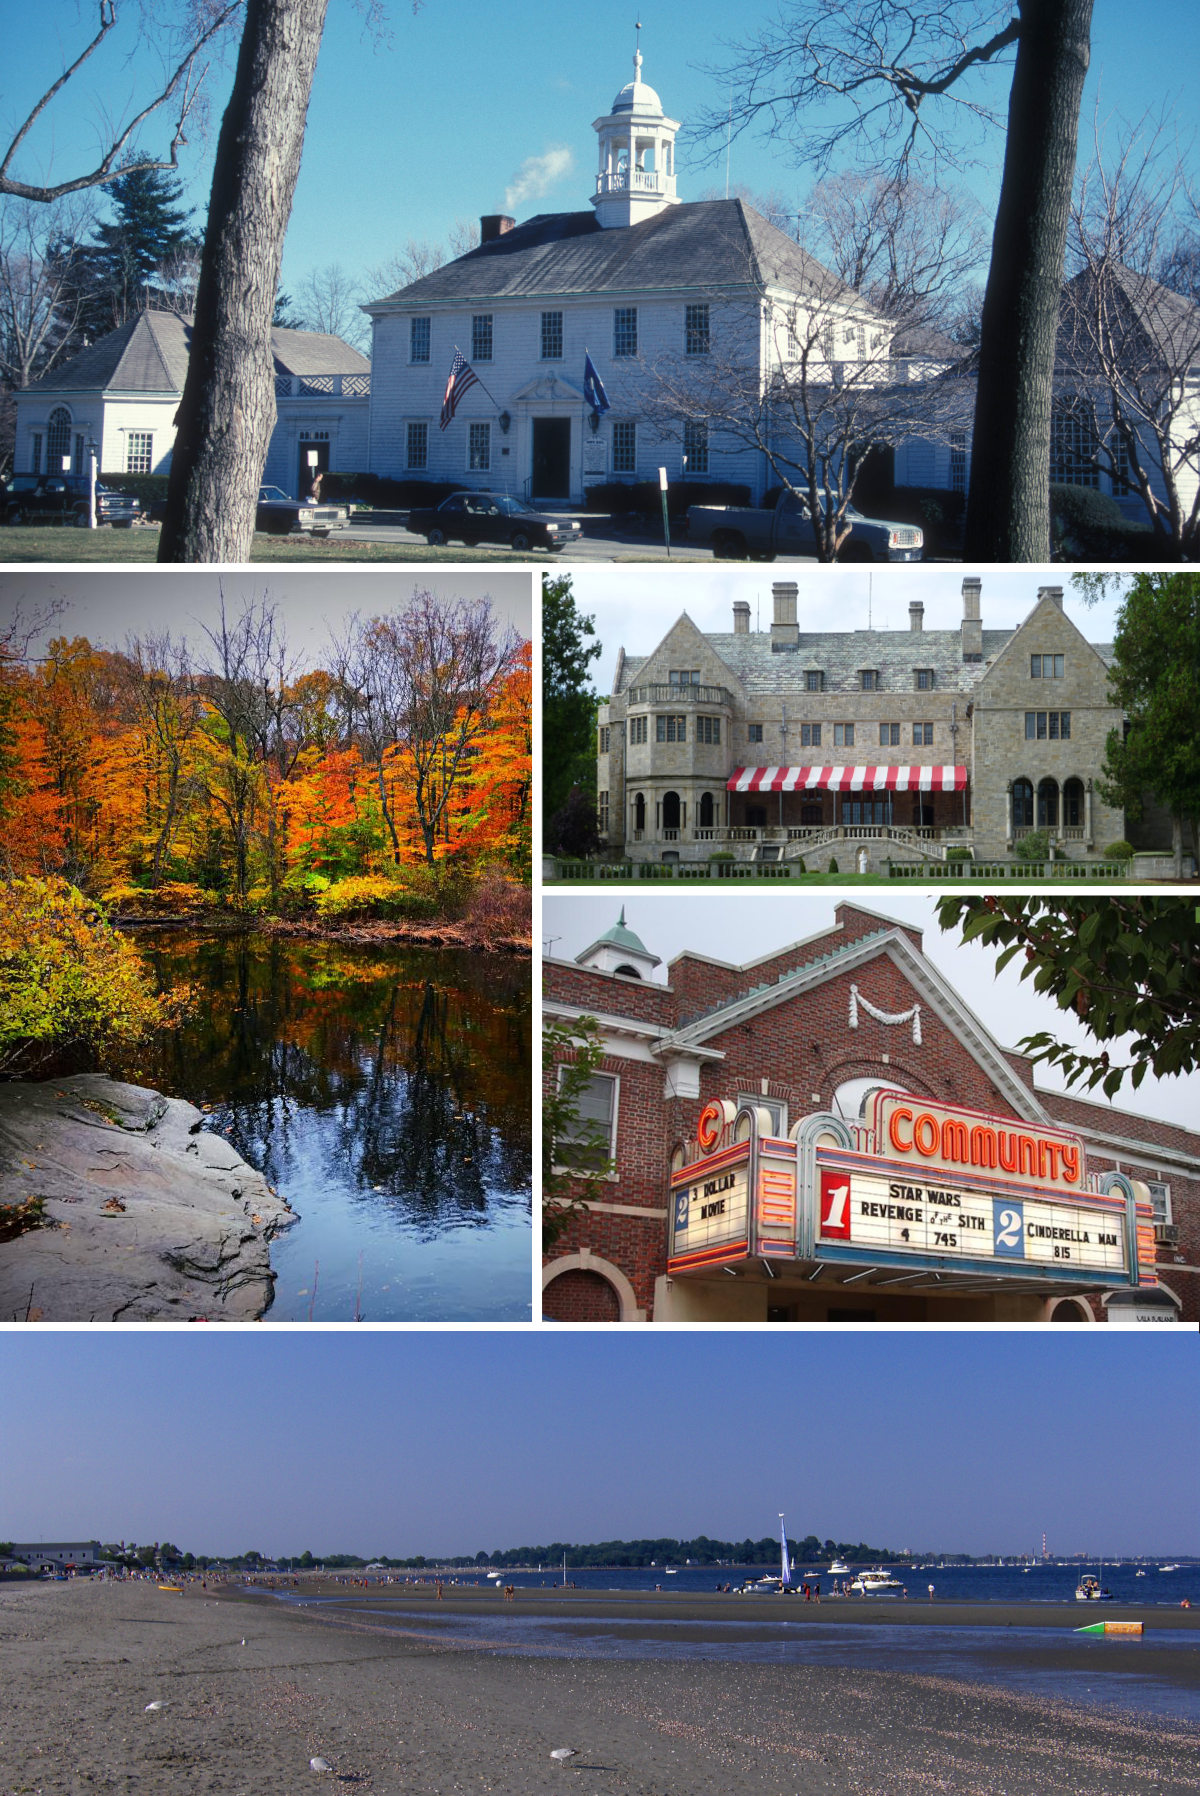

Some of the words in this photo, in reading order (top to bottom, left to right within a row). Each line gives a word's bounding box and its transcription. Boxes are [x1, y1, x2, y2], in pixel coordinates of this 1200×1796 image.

[692, 1187, 698, 1200] 3
[703, 1173, 735, 1198] DOLLAR
[890, 1183, 923, 1202] STAR
[927, 1189, 961, 1208] WARS
[676, 1196, 688, 1224] 2
[701, 1199, 725, 1220] MOVIE
[822, 1185, 849, 1228] 1
[861, 1202, 923, 1222] REVENGE
[930, 1211, 939, 1224] OF
[939, 1213, 952, 1225] THE
[958, 1214, 985, 1231] SITH
[900, 1228, 909, 1242] 4
[934, 1232, 957, 1247] 745
[996, 1209, 1022, 1247] 2
[1027, 1222, 1090, 1244] CINDERELLA
[1098, 1232, 1117, 1246] MAN
[1054, 1245, 1070, 1259] 815
